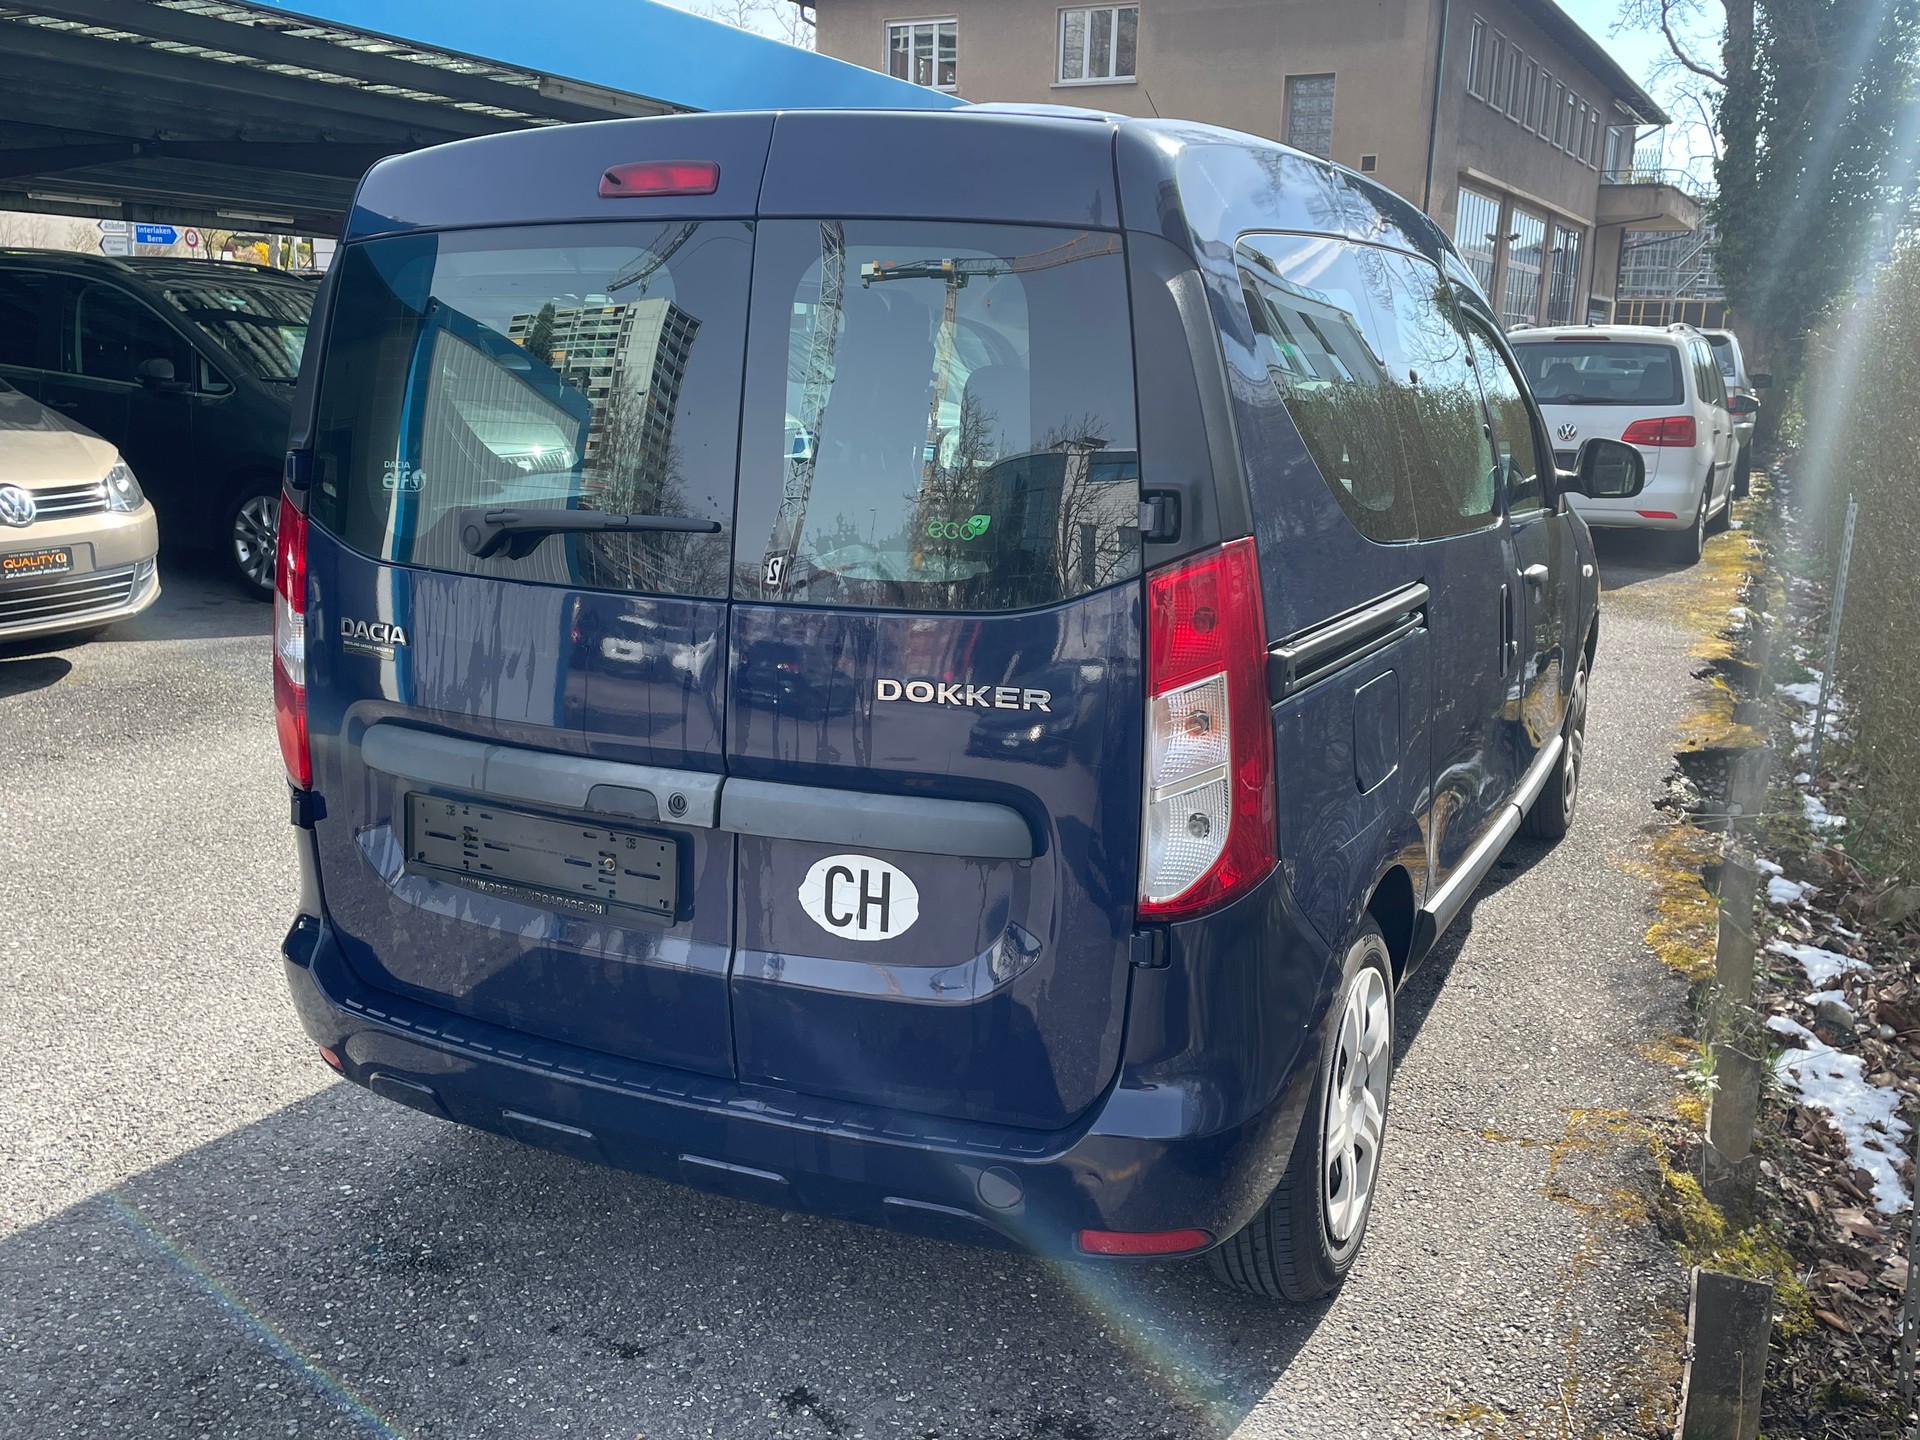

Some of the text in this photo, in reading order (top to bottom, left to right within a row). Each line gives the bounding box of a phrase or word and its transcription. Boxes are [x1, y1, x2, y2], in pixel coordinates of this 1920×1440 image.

[137, 225, 172, 234] Interlaken
[146, 235, 163, 243] Bern
[383, 460, 411, 469] DACIA
[3, 554, 55, 569] QUALITY
[341, 616, 407, 646] DACIA
[876, 679, 1052, 712] DOKKER
[824, 865, 891, 933] CH
